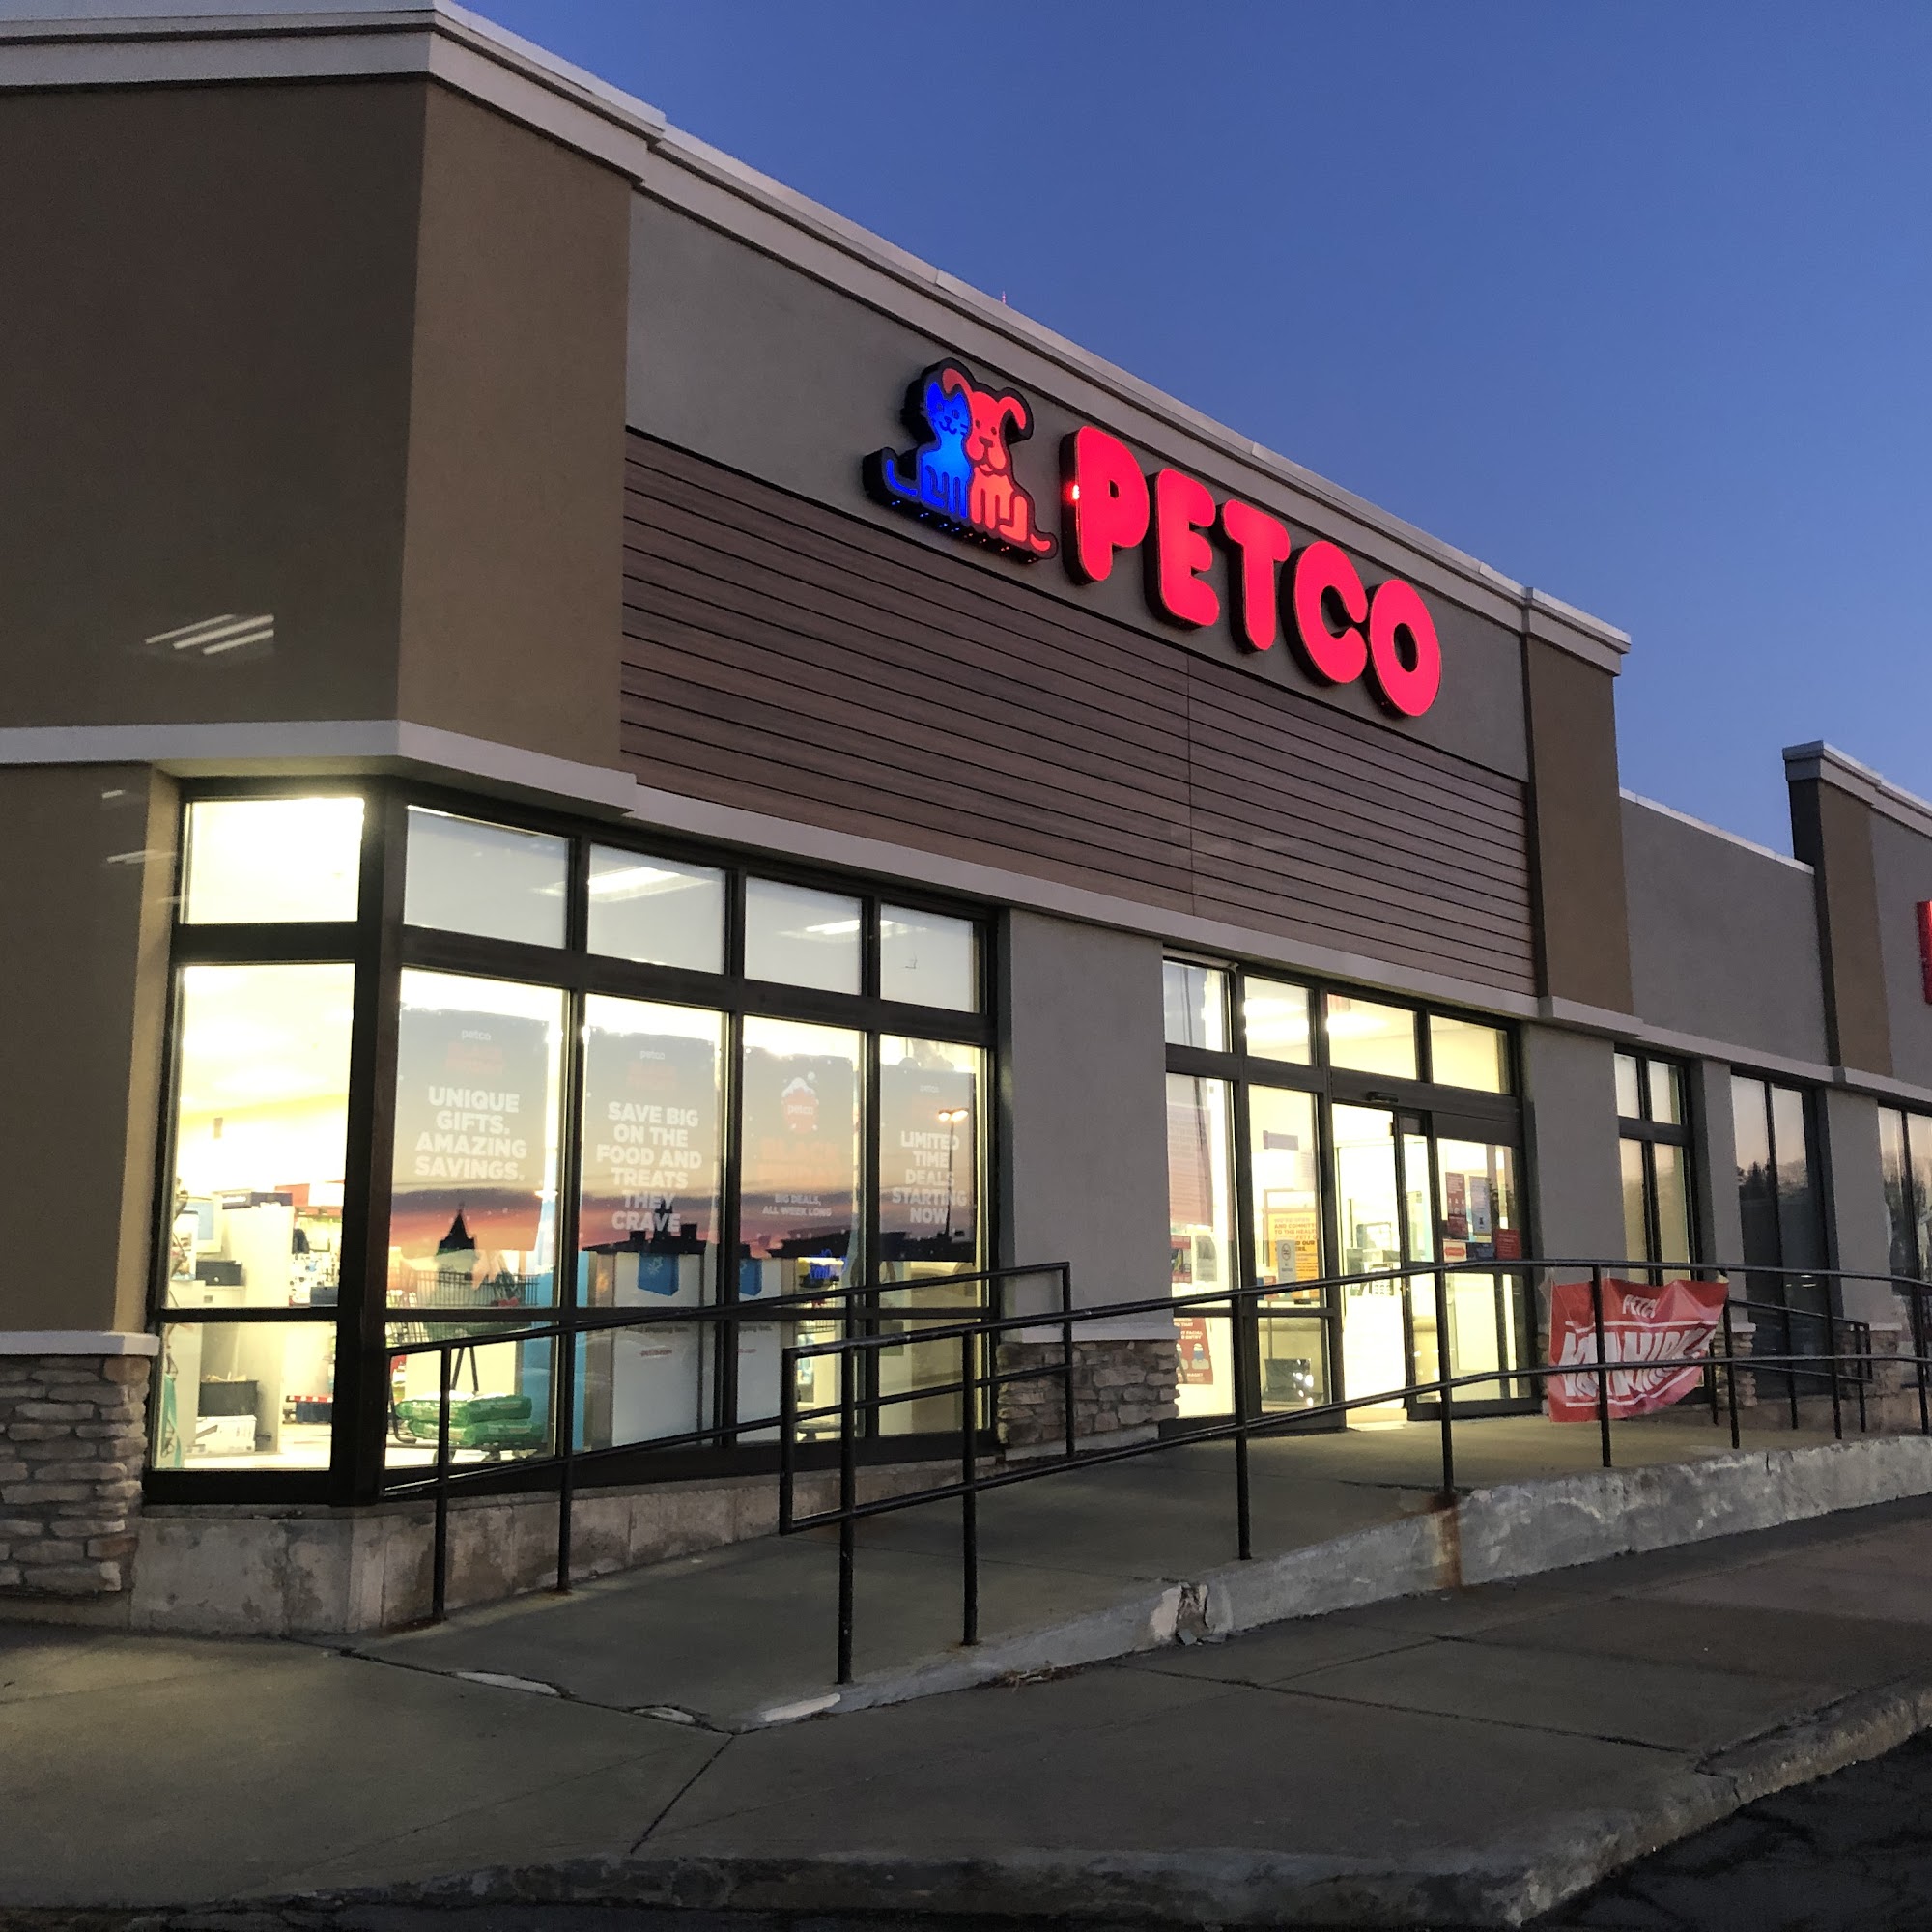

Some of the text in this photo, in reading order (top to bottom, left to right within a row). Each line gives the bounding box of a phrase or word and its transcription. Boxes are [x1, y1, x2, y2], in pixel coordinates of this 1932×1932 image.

[1074, 425, 1442, 717] PETCO
[461, 1029, 492, 1041] petco
[428, 1086, 520, 1113] UNIQUE
[436, 1110, 510, 1135] GIFTS.
[608, 1101, 699, 1127] SAVE BIG
[415, 1131, 527, 1159] AMAZING
[613, 1123, 689, 1148] ON THE
[900, 1130, 960, 1151] LIMITED
[414, 1155, 526, 1181] SAVINGS.
[596, 1144, 703, 1169] FOOD AND
[912, 1151, 950, 1169] TIME
[611, 1166, 689, 1189] TREATS
[905, 1168, 955, 1188] DEALS
[622, 1189, 676, 1210] THEY
[892, 1187, 967, 1207] STARTING
[611, 1210, 681, 1232] CRAVE
[910, 1208, 949, 1225] NOW
